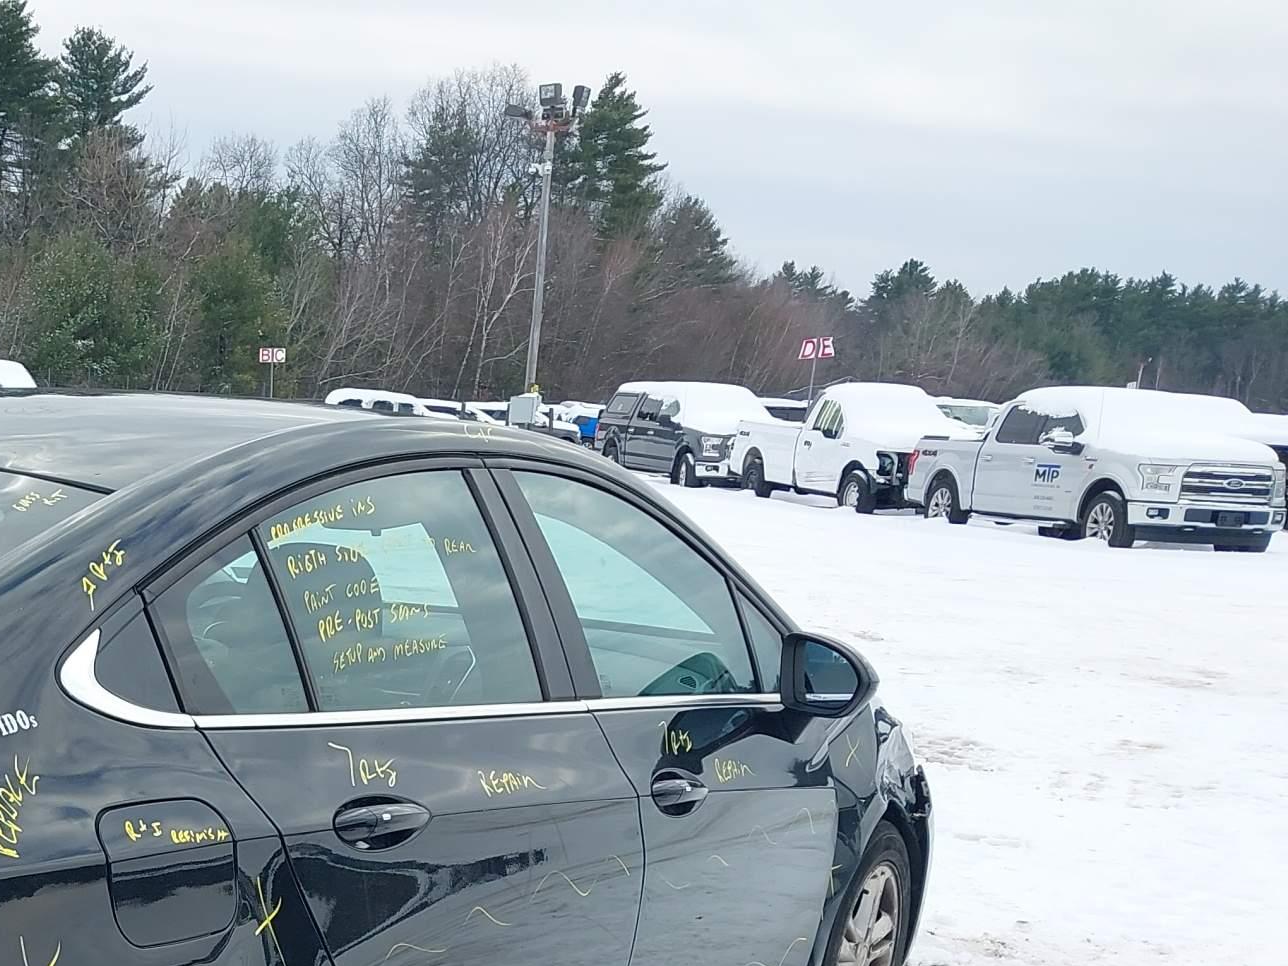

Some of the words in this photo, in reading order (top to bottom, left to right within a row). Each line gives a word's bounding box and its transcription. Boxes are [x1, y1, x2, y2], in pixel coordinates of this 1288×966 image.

[1034, 463, 1062, 483] MTP
[318, 609, 344, 643] PRE
[355, 607, 381, 632] POST
